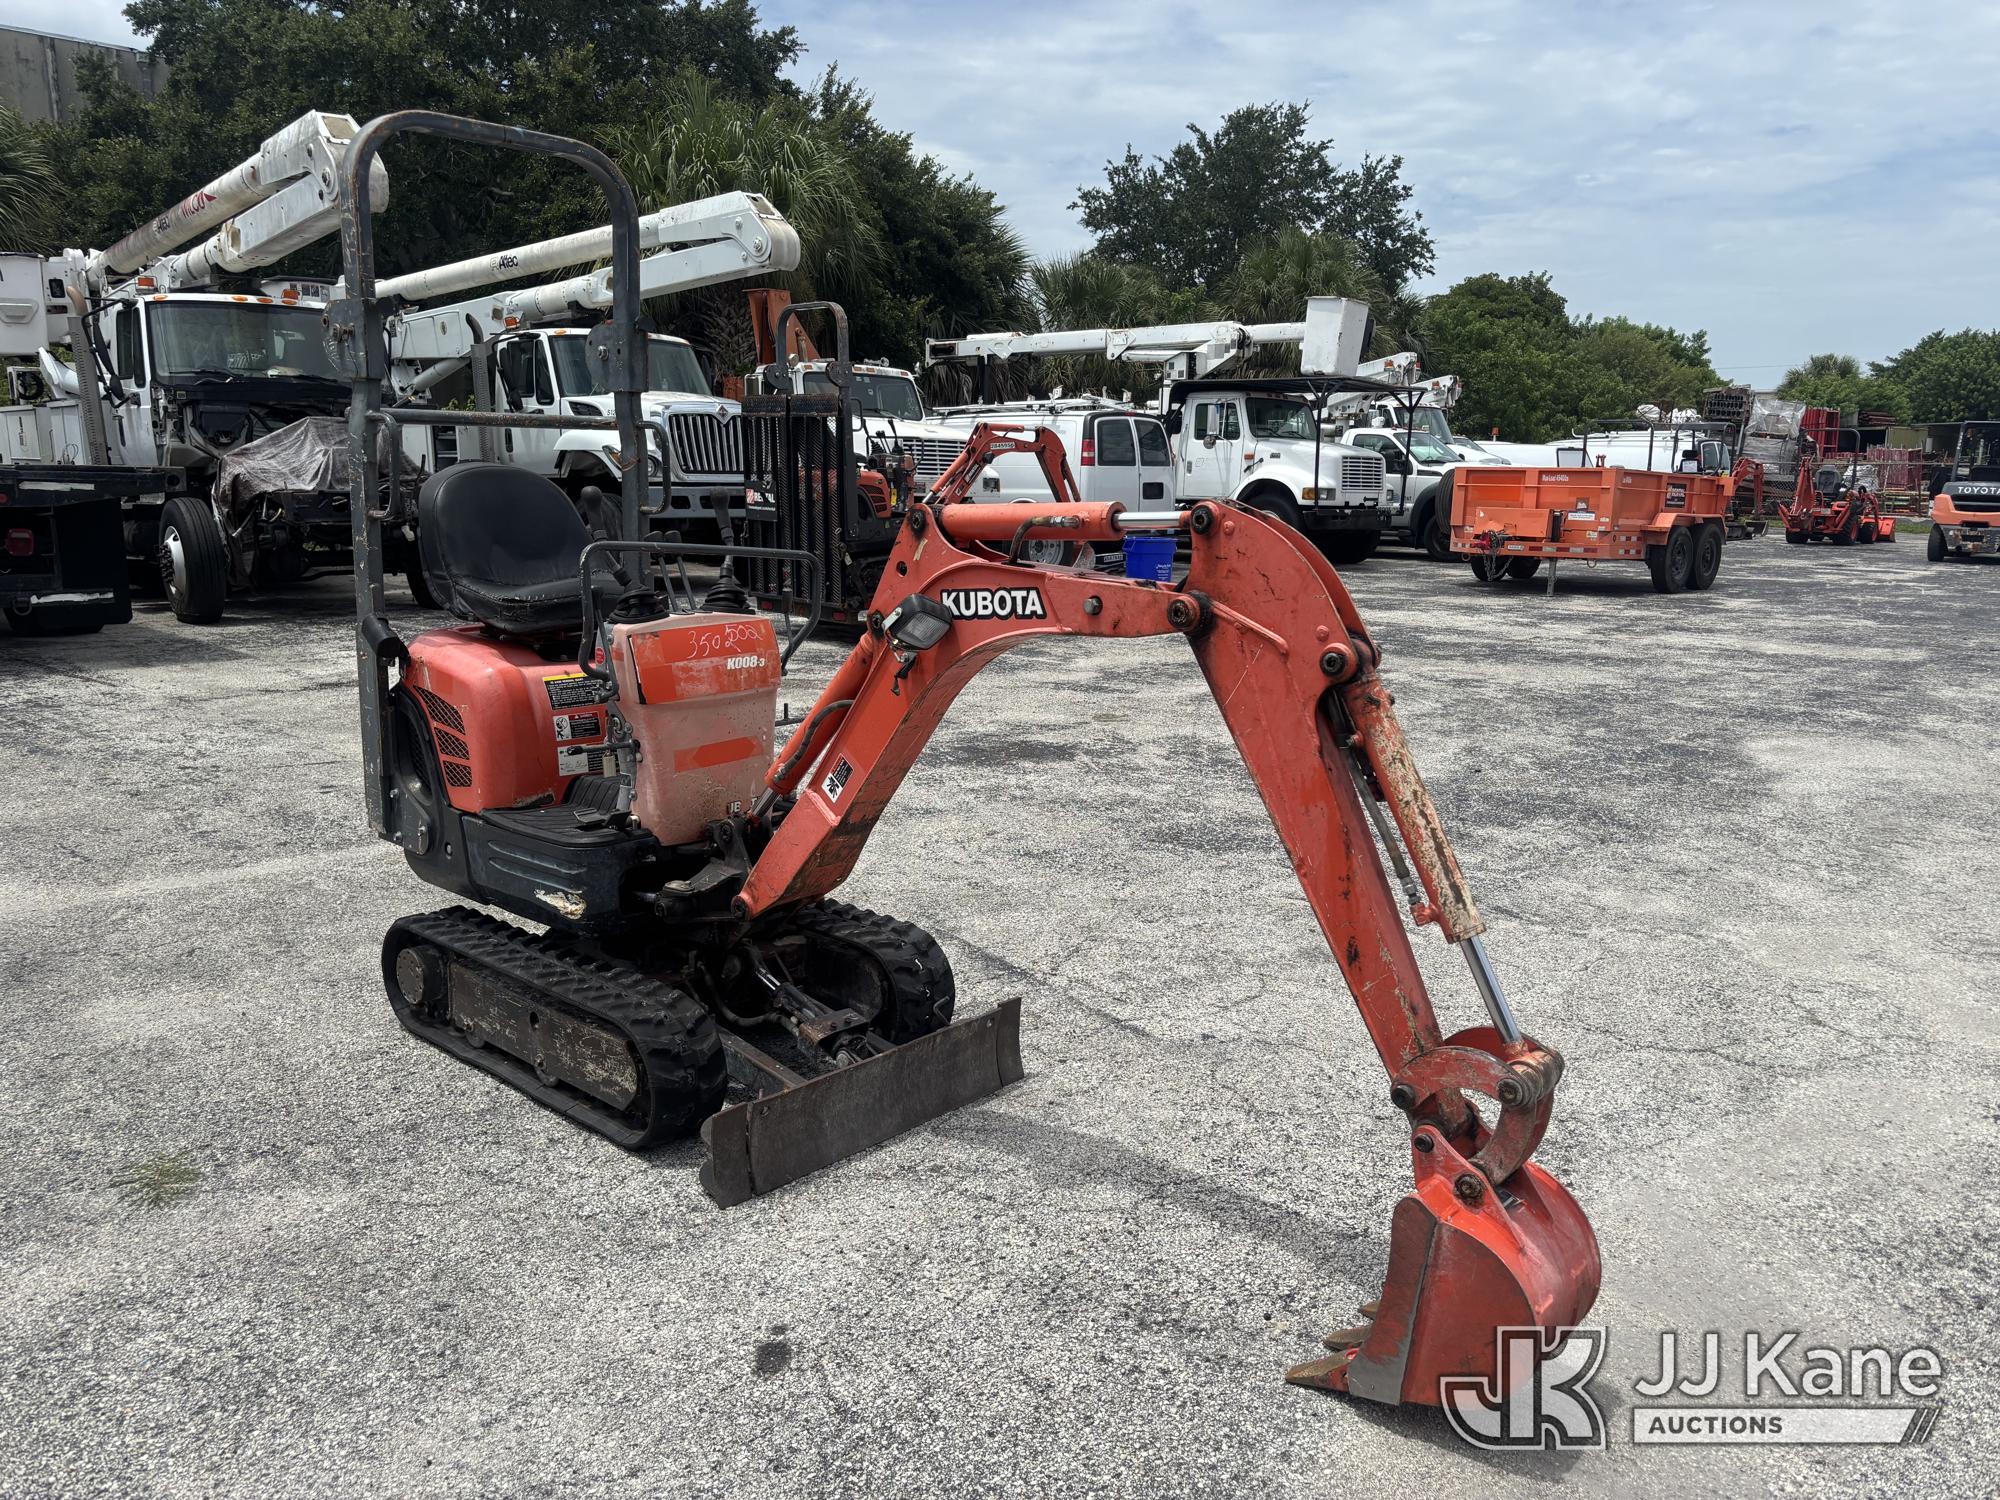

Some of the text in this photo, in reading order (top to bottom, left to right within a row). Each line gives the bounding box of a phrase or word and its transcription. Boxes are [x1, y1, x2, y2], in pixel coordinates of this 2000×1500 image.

[499, 254, 519, 270] Altec
[942, 589, 1044, 616] KUBOTA
[727, 655, 765, 670] K008-3
